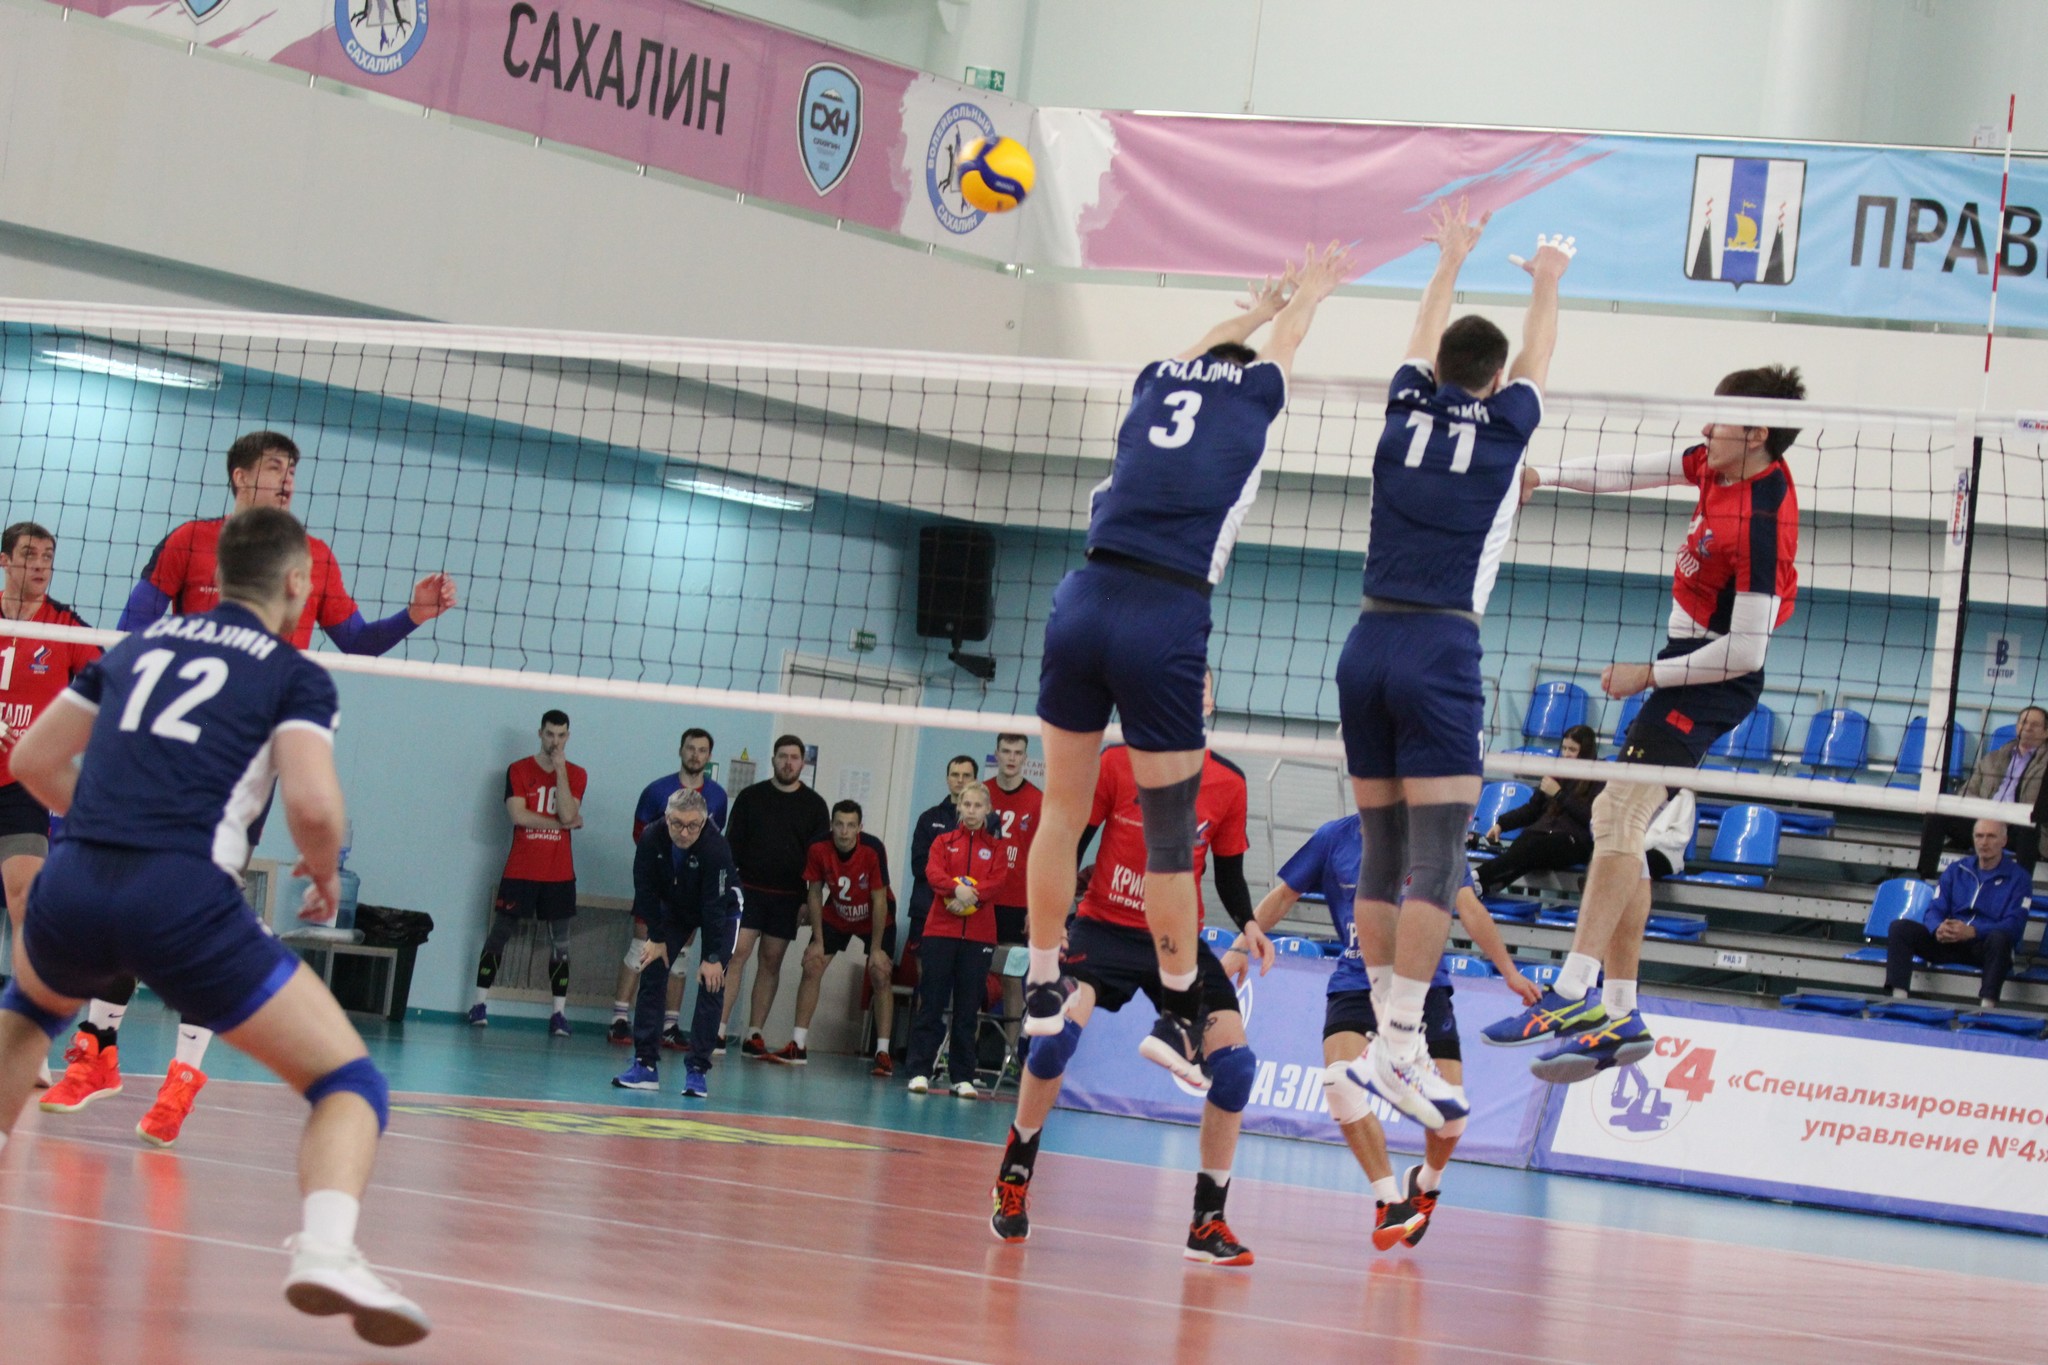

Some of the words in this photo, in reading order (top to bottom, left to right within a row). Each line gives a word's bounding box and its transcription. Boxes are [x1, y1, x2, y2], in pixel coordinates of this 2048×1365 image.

[345, 39, 403, 73] САХАЛИН
[503, 2, 731, 136] САХАЛИН
[936, 203, 979, 233] САХАЛИН
[1850, 194, 2048, 280] ПРАВ
[1148, 389, 1203, 449] 3
[1405, 410, 1477, 474] 11
[118, 647, 229, 745] 12
[838, 877, 851, 900] 2
[1664, 1047, 1717, 1103] 4
[1727, 1069, 2048, 1126] «Специализированно
[1800, 1117, 1979, 1156] управление
